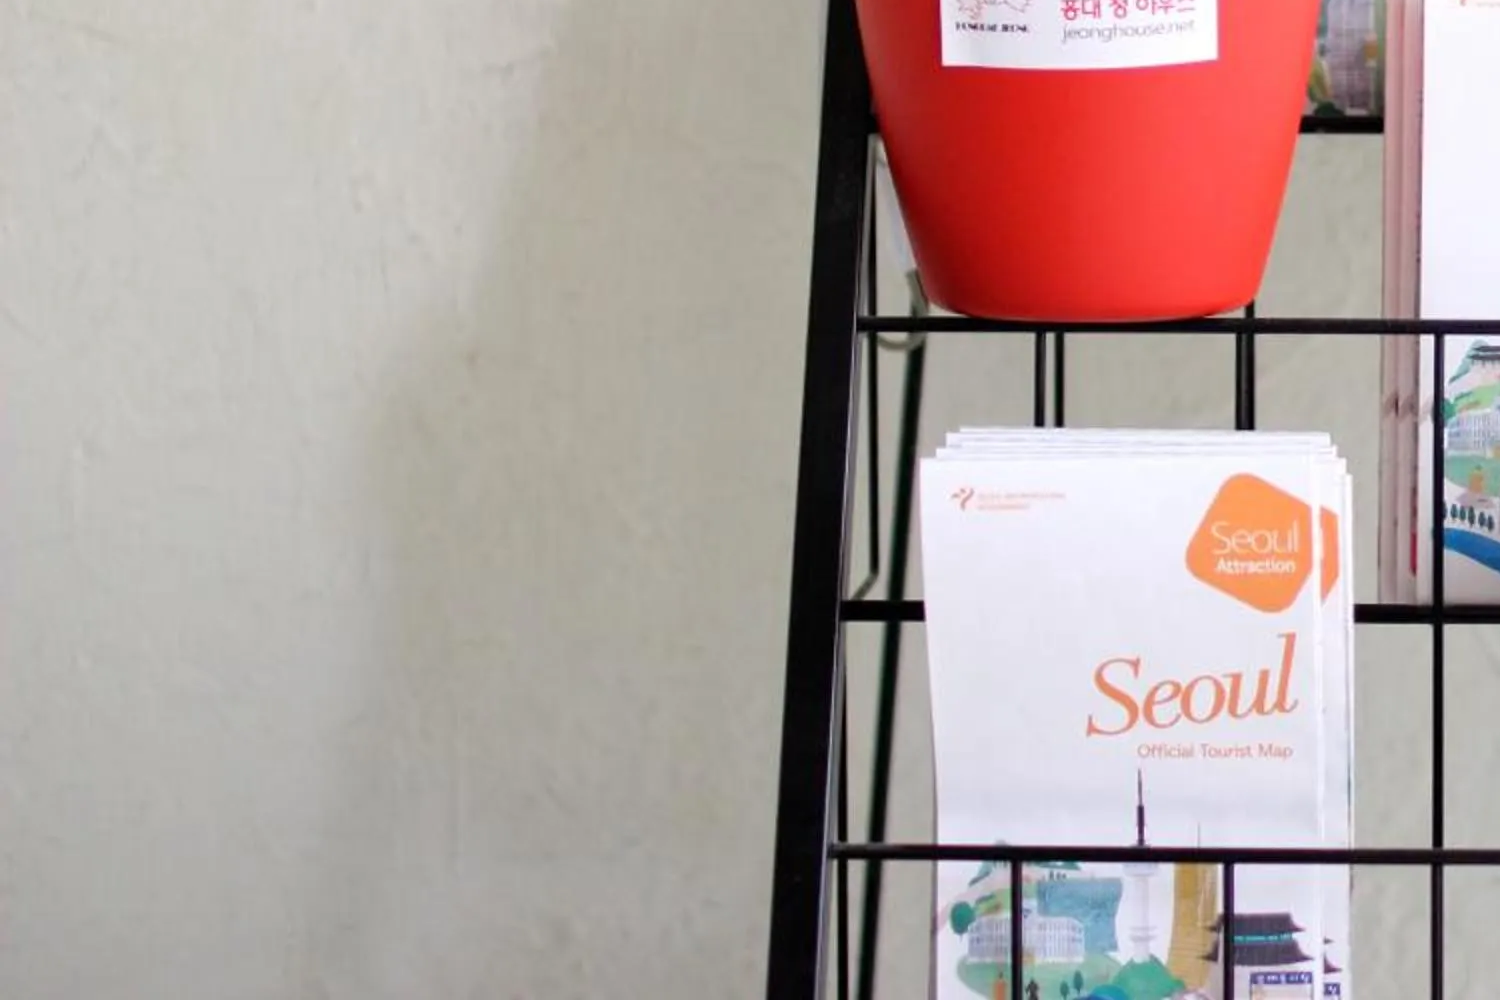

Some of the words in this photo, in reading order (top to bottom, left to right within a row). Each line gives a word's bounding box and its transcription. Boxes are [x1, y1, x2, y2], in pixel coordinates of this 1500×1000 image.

[1061, 18, 1196, 44] jeonghouse.net
[1211, 520, 1299, 554] Seoul
[1214, 557, 1296, 574] Attraction
[1086, 632, 1298, 737] Seoul
[1137, 742, 1194, 759] Official
[1200, 742, 1252, 759] Tourist
[1258, 743, 1293, 762] Map
